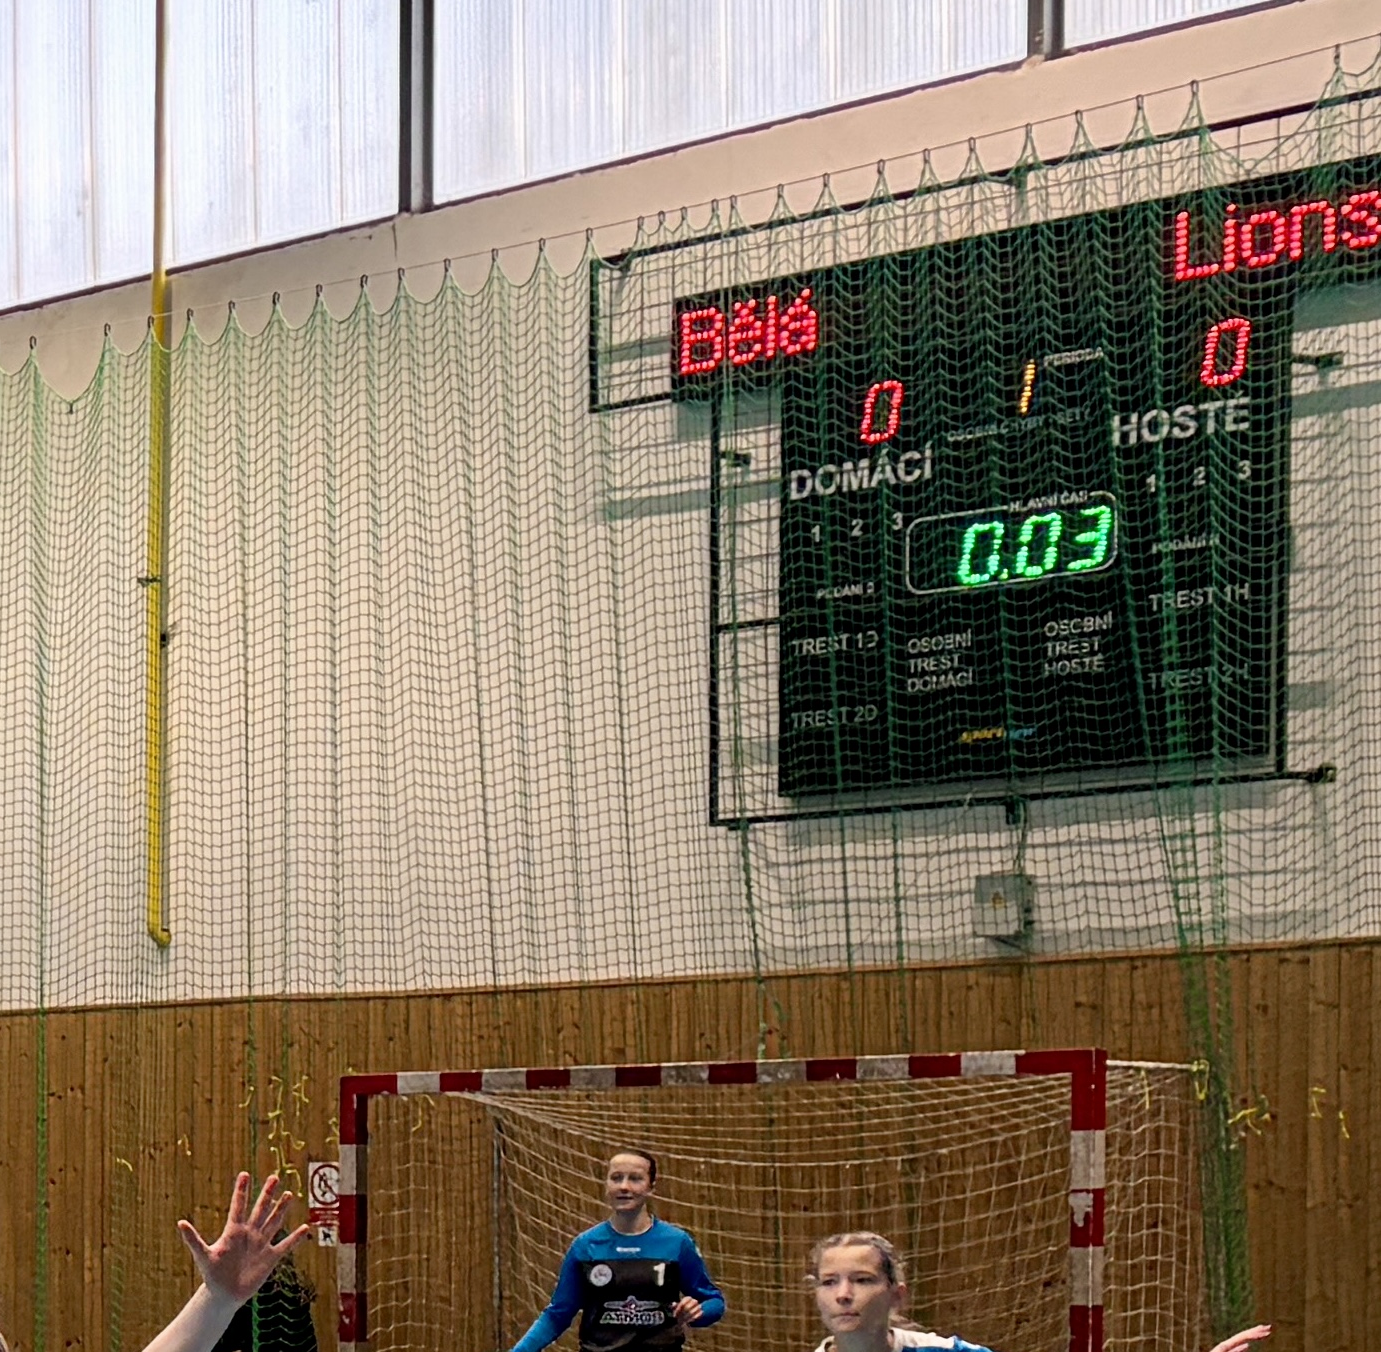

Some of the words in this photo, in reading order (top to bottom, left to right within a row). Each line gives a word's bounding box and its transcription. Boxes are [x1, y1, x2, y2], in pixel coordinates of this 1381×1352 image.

[1174, 190, 1381, 281] Lions
[679, 287, 820, 377] Bělá
[1200, 317, 1252, 388] 0
[860, 379, 905, 444] 0
[789, 441, 934, 501] DOMÁCÍ
[811, 524, 821, 543] 1
[851, 518, 864, 537] 2
[892, 512, 904, 531] 3
[653, 1262, 666, 1287] 1
